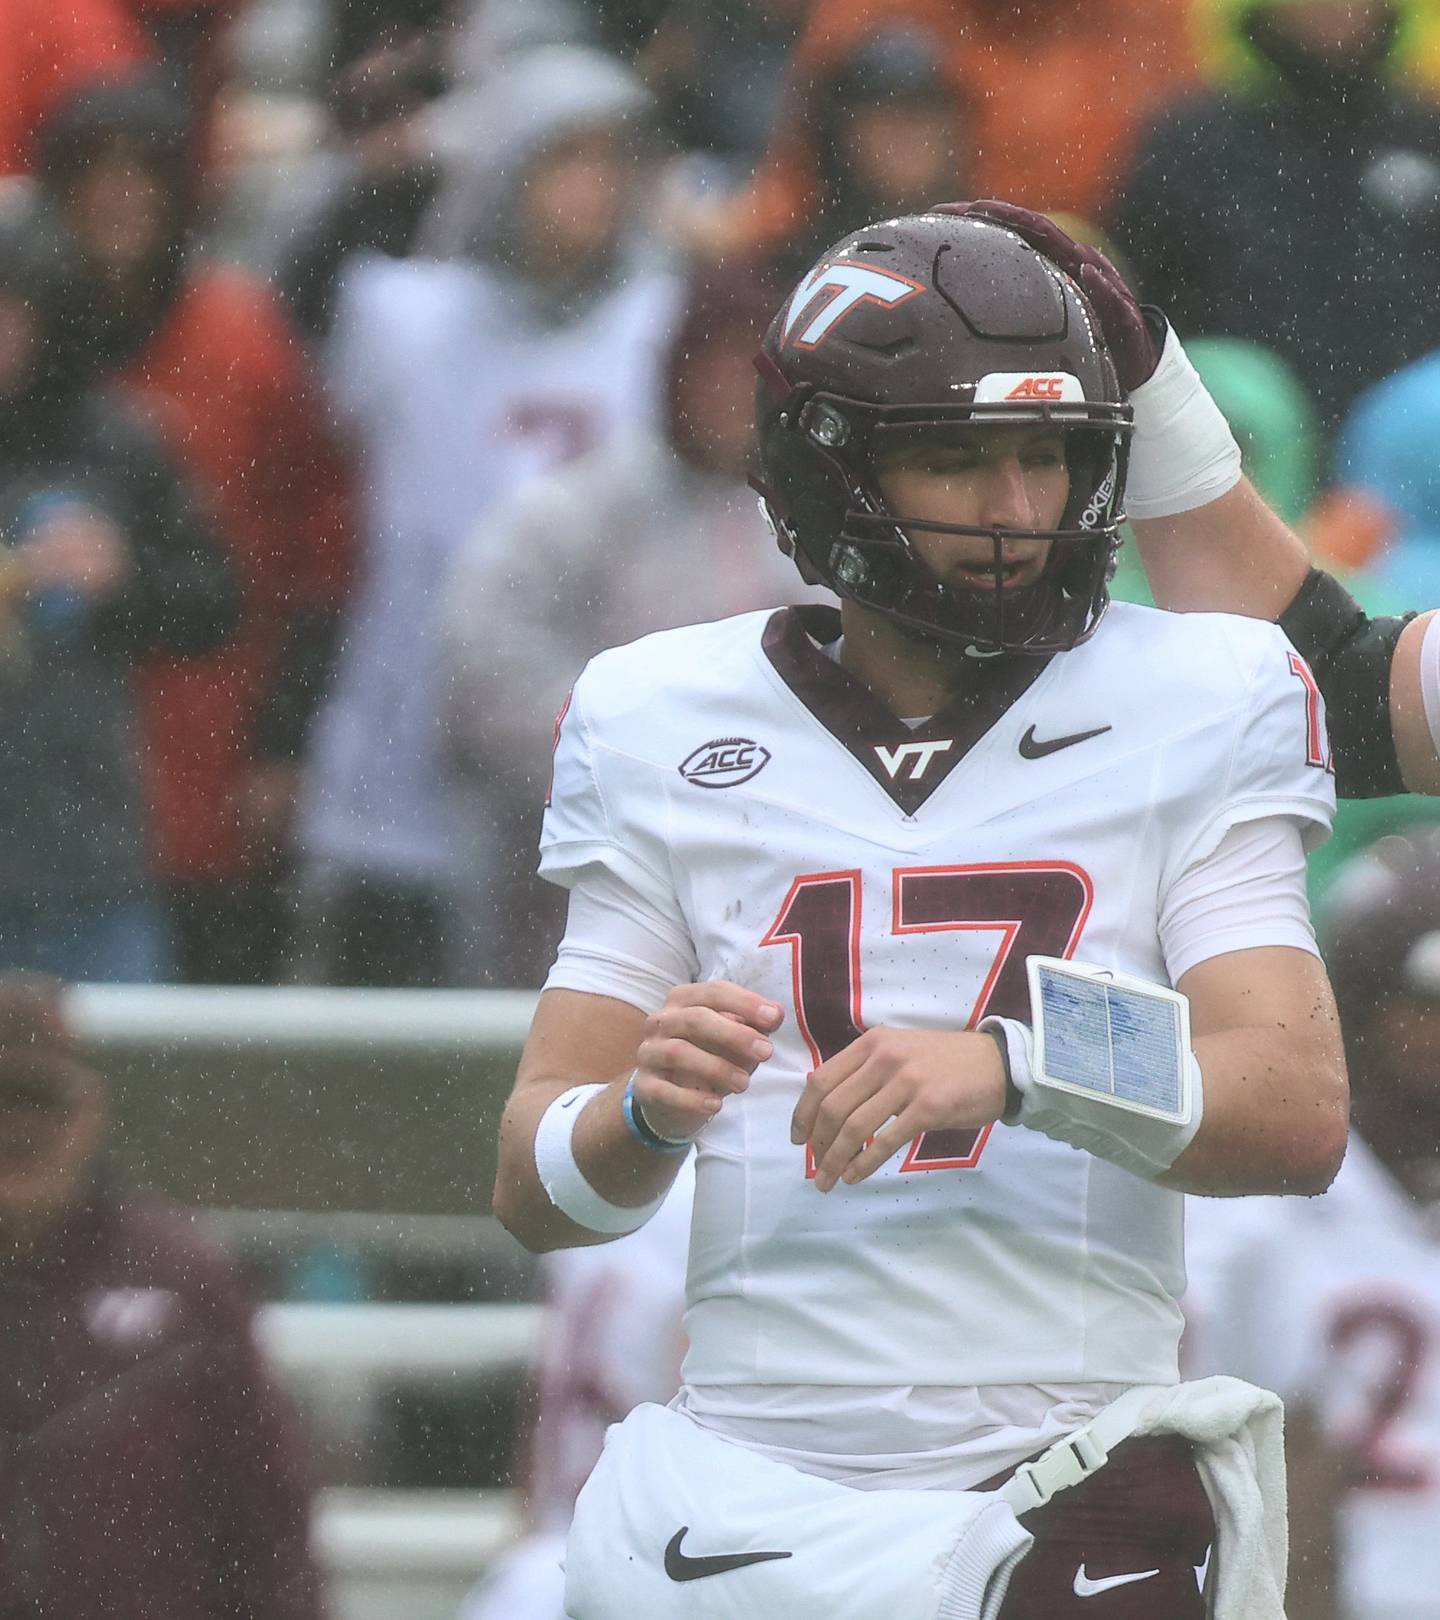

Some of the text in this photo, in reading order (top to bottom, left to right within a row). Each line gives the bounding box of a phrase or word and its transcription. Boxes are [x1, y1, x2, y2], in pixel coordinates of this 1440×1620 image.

[780, 260, 926, 351] VT
[1005, 378, 1063, 400] ACC
[1286, 651, 1336, 775] 1
[692, 746, 757, 771] ACC
[873, 739, 953, 779] VT
[758, 860, 1094, 1179] 17
